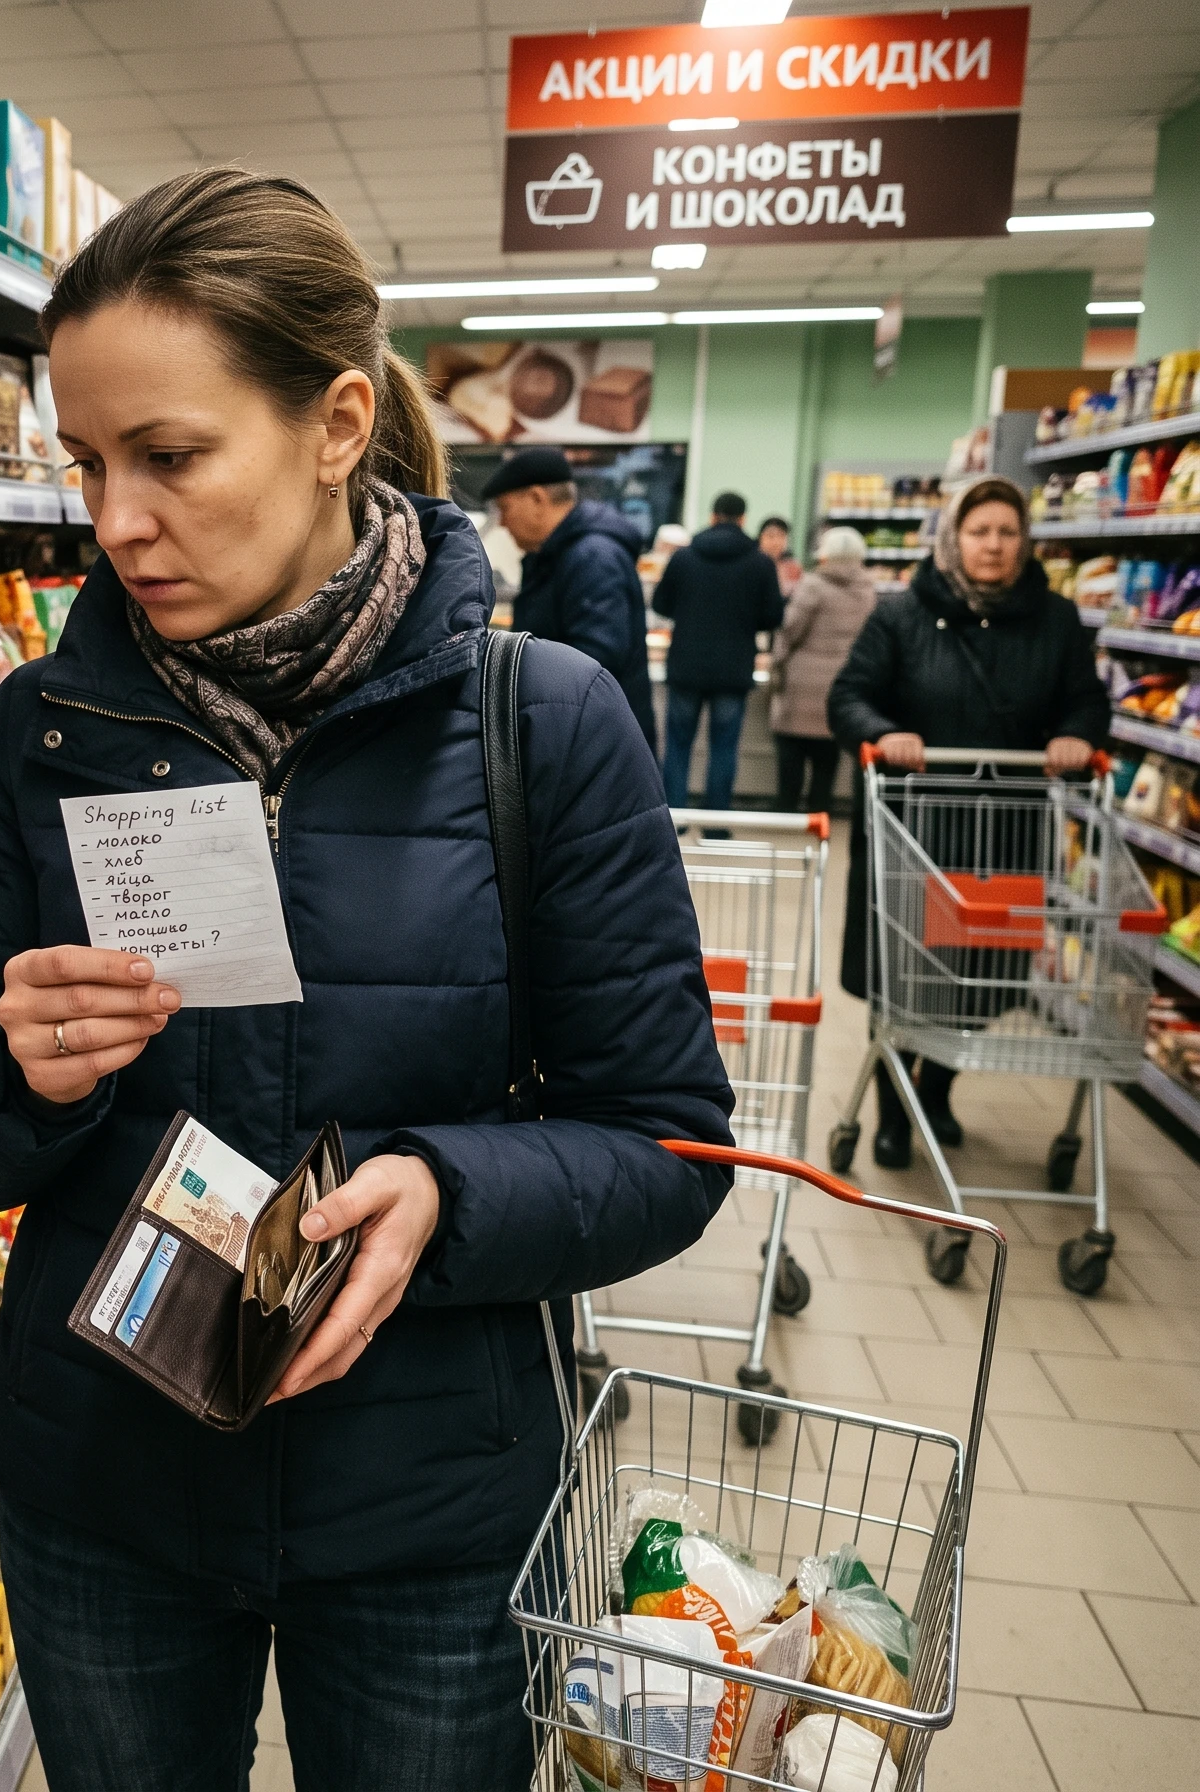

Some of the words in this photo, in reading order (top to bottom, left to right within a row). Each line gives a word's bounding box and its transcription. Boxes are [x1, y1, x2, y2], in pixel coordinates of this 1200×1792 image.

[539, 51, 714, 104] АКЦИИ
[727, 48, 764, 92] И
[776, 38, 992, 92] СКИДКИ
[653, 137, 882, 186] КОНФЕТЫ
[626, 193, 658, 231] И
[670, 183, 906, 229] ШОКОЛАД
[84, 804, 174, 830] Shopping
[190, 795, 228, 816] list
[96, 833, 162, 849] молоко
[104, 849, 145, 868] хлеб
[105, 872, 154, 887] яйца
[110, 889, 171, 907] творог
[114, 907, 171, 921] масло
